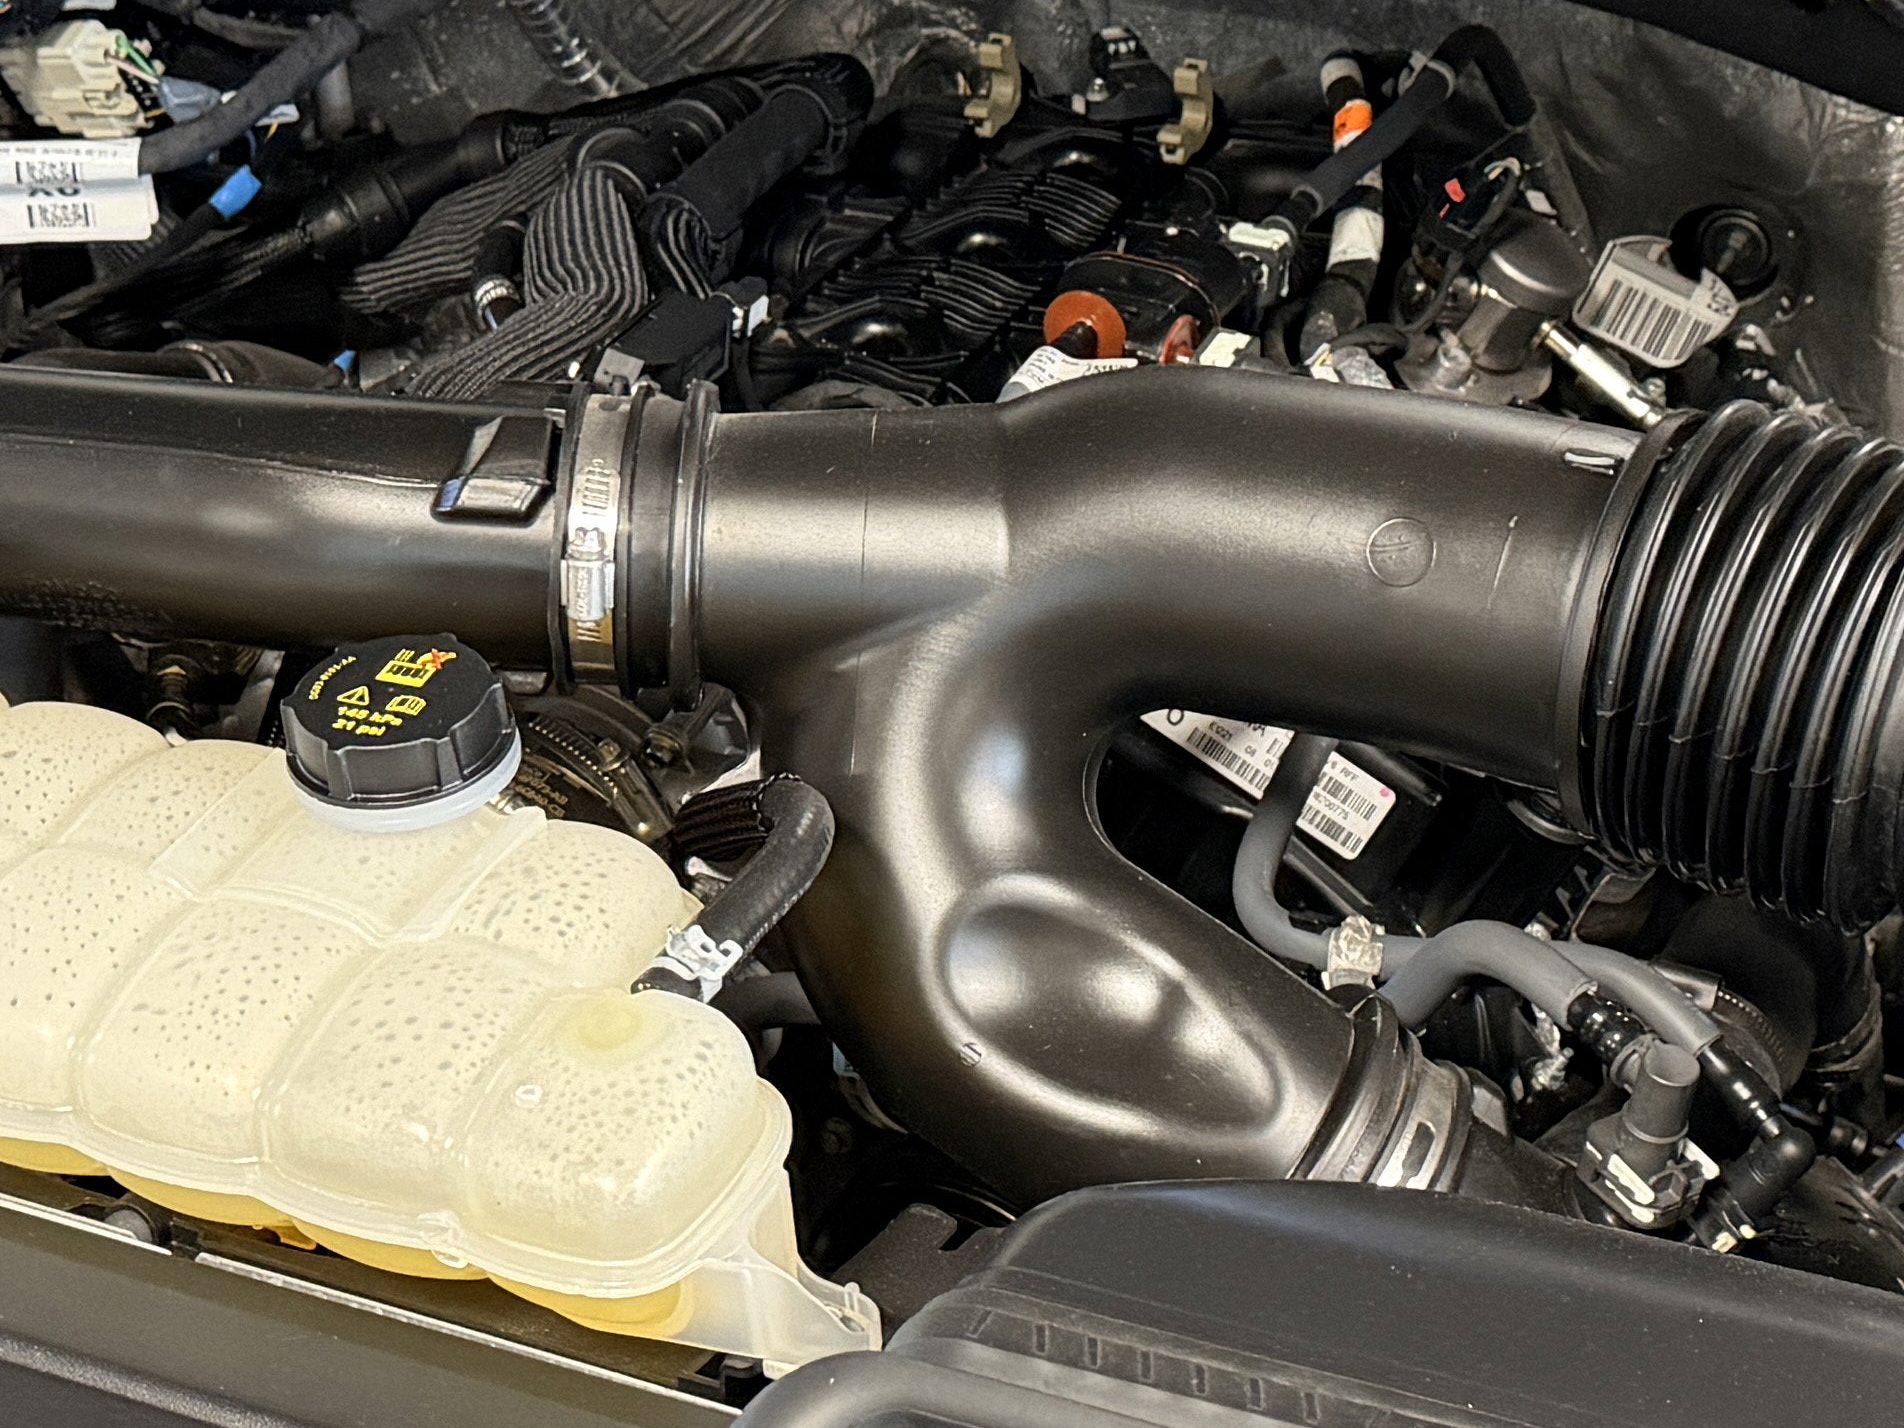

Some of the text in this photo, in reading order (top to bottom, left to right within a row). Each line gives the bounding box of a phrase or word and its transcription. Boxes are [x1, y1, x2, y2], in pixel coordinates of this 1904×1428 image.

[338, 706, 403, 727] 145 kPa
[331, 718, 386, 737] 21 psi
